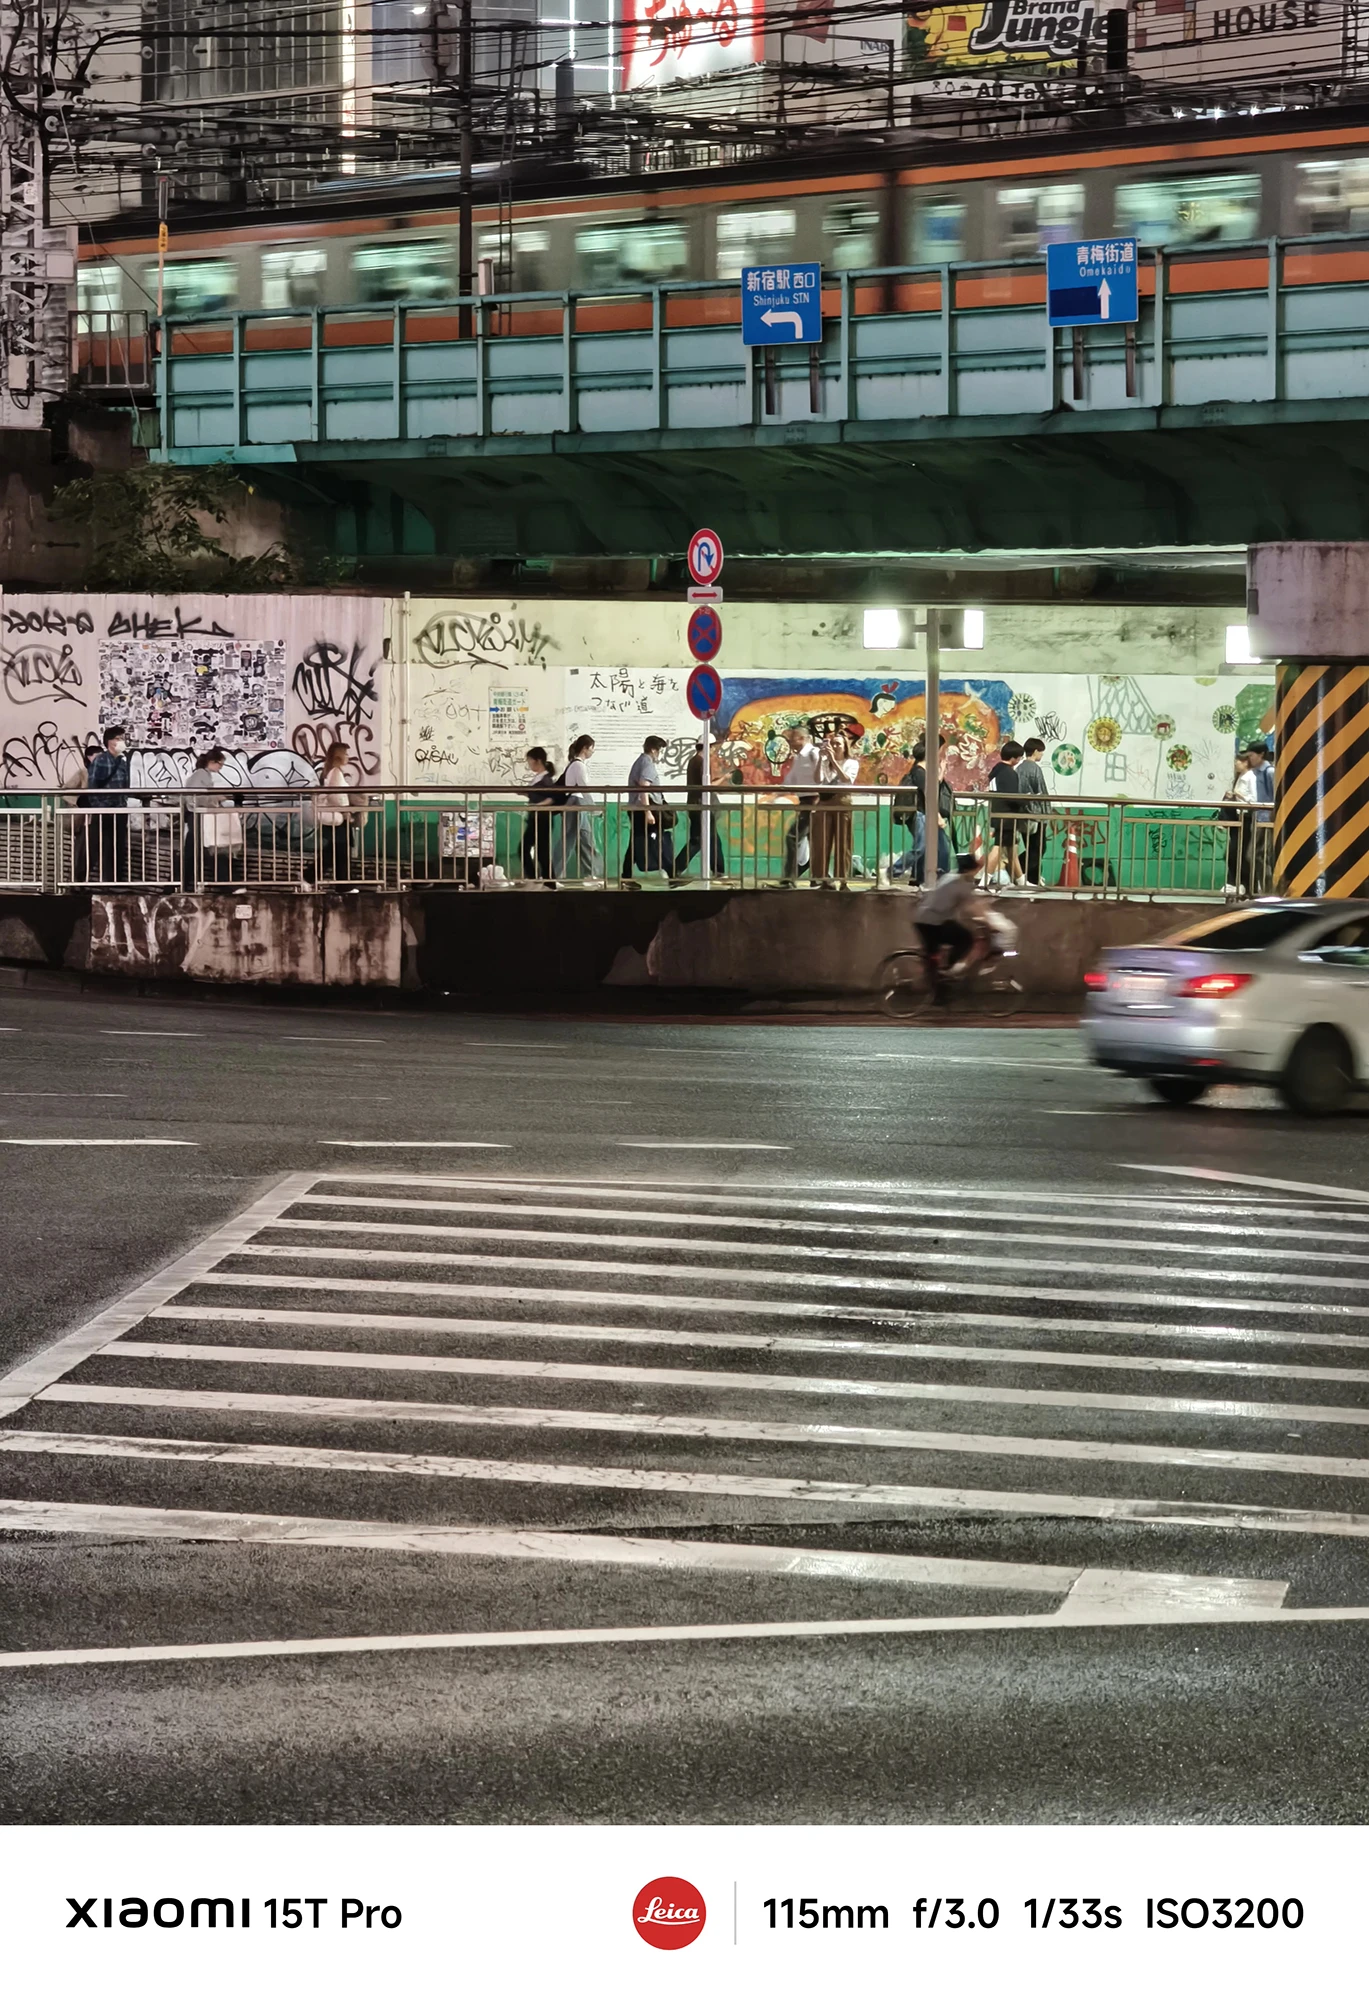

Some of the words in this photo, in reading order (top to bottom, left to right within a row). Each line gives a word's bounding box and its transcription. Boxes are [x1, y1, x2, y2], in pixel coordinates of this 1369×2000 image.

[1213, 1, 1318, 38] HOUSE
[1077, 242, 1134, 265] 青梅街道
[747, 269, 791, 291] 新宿駅
[793, 272, 815, 288] 西口
[753, 293, 790, 308] Shinjuku
